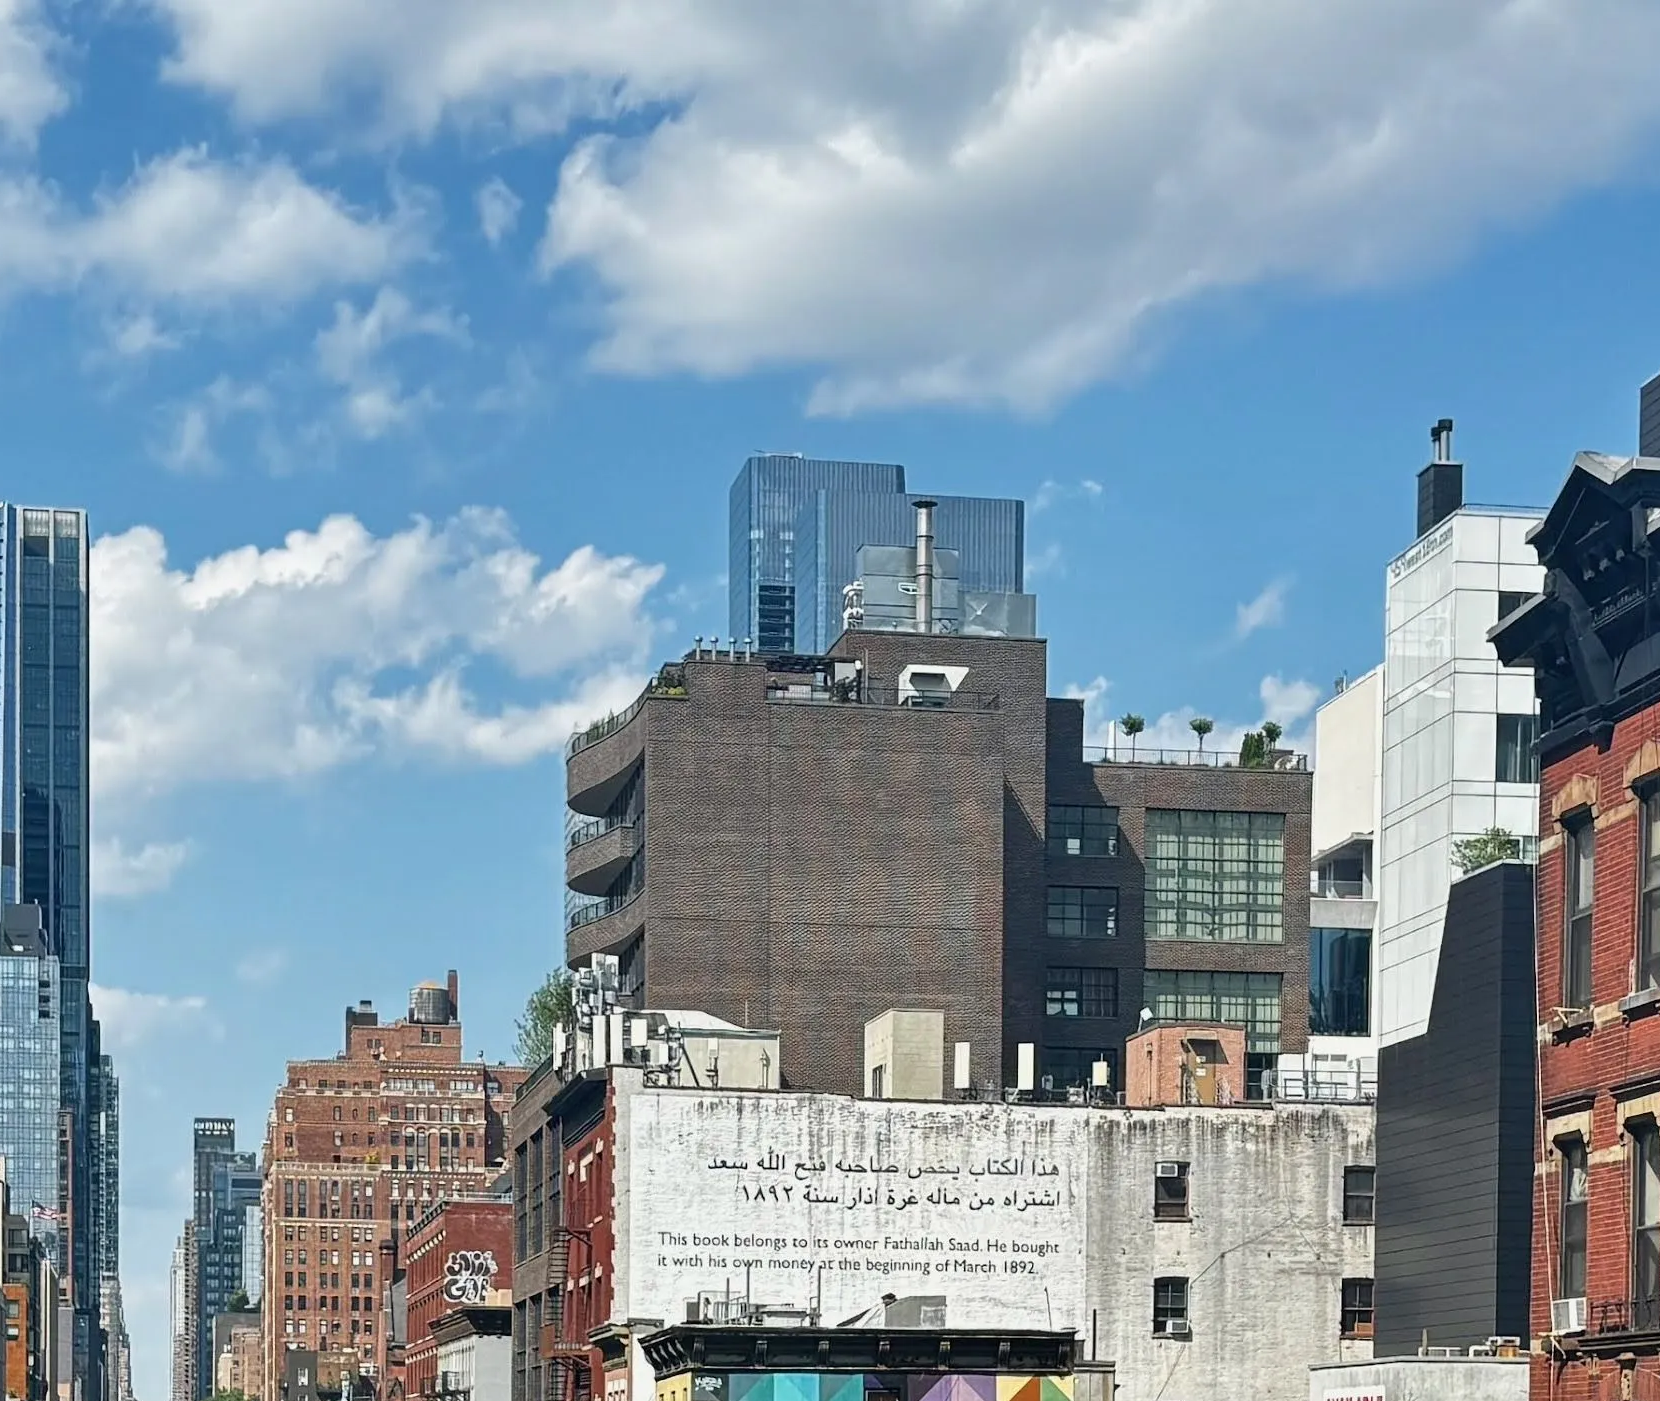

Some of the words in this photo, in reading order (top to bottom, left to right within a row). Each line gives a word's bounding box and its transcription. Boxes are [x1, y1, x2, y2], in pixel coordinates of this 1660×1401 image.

[708, 1156, 748, 1170] سعد
[757, 1146, 786, 1170] الله
[794, 1157, 826, 1180] فتح
[835, 1156, 899, 1178] صاحبه
[908, 1158, 961, 1180] يخص
[1032, 1157, 1060, 1177] هذا
[968, 1157, 1025, 1182] الكتاب
[743, 1184, 793, 1203] ١٨٩٢
[803, 1184, 839, 1203] سنة
[887, 1188, 919, 1210] غرة
[969, 1192, 995, 1210] من
[658, 1231, 688, 1247] This
[693, 1233, 730, 1247] book
[734, 1233, 788, 1251] belongs
[792, 1236, 808, 1248] to
[813, 1235, 829, 1249] its
[833, 1238, 879, 1250] owner
[884, 1236, 944, 1251] Fathallah
[948, 1237, 983, 1252] Saad.
[987, 1239, 1007, 1253] He
[1012, 1240, 1060, 1257] bought
[657, 1253, 668, 1267] it
[672, 1253, 703, 1267] with
[708, 1254, 728, 1268] his
[732, 1258, 763, 1269] own
[768, 1258, 815, 1273] money
[819, 1259, 836, 1271] at
[838, 1257, 861, 1271] the
[866, 1258, 931, 1275] beginning
[935, 1259, 951, 1272] of
[954, 1259, 997, 1273] March
[1004, 1260, 1039, 1274] 1892.
